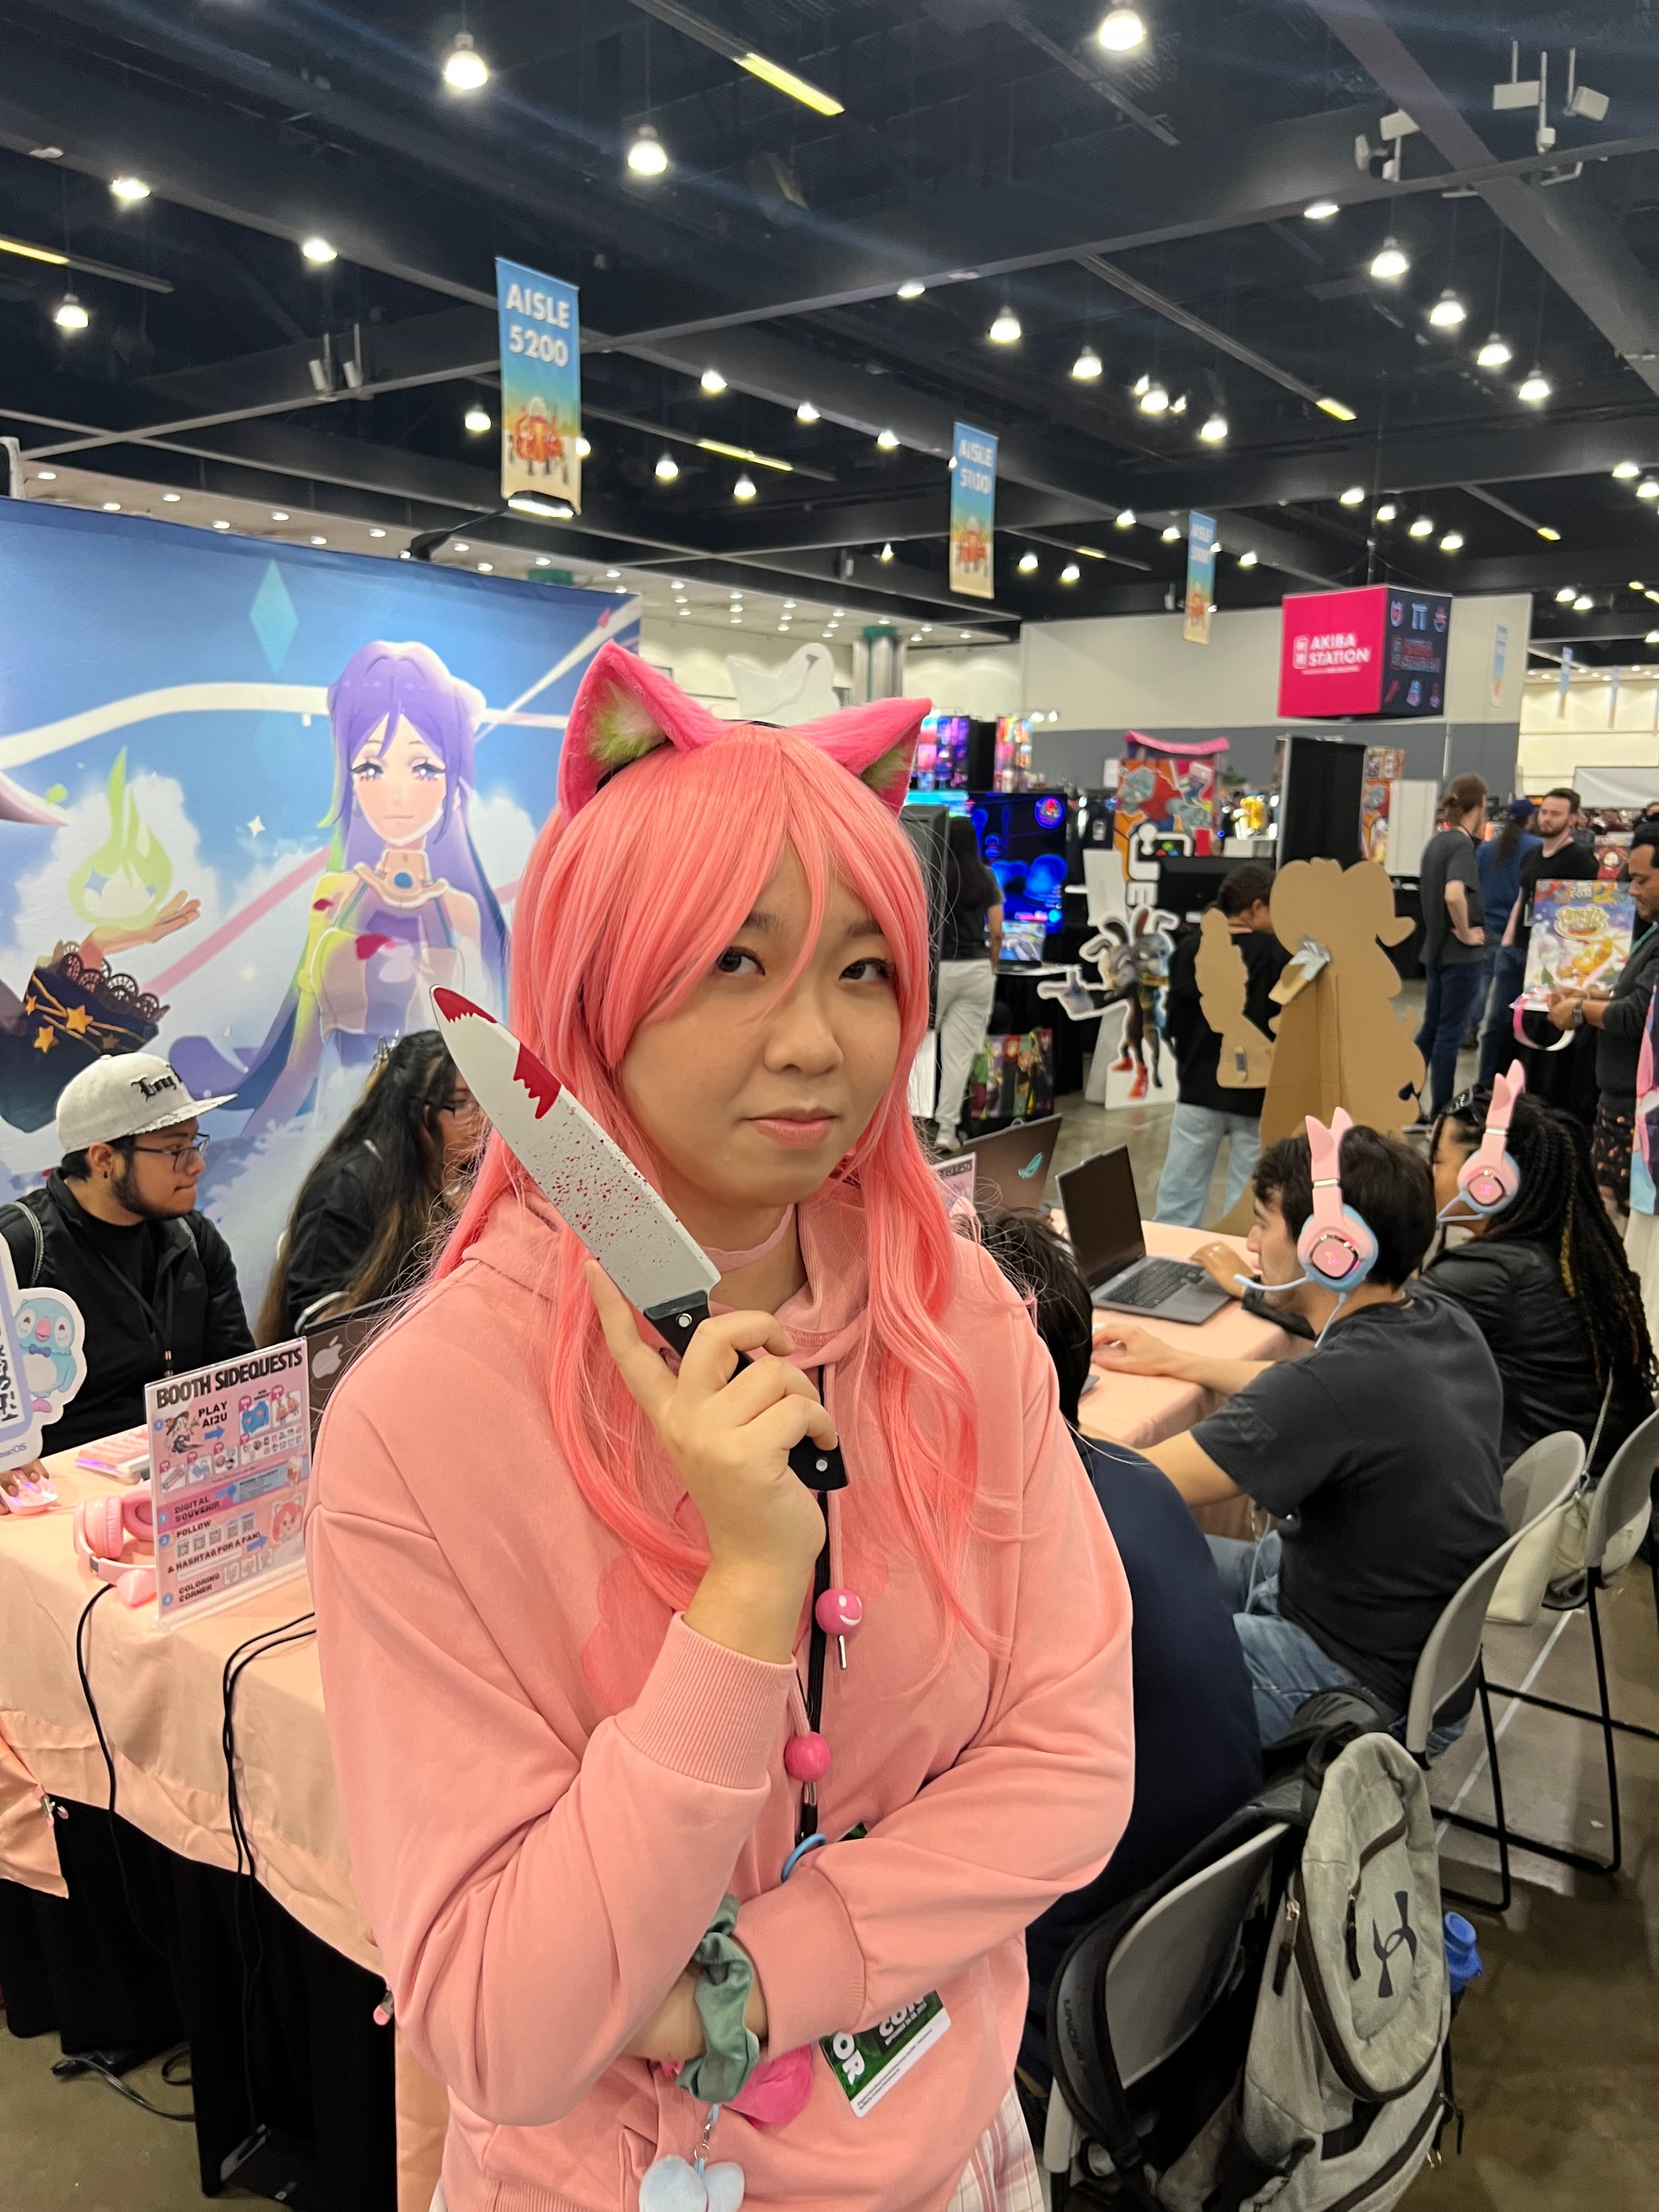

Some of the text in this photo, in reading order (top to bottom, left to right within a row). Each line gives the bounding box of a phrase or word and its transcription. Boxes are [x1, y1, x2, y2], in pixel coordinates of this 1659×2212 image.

[505, 284, 569, 329] AISLE
[509, 325, 568, 368] 5200
[959, 439, 992, 467] AISLE
[1310, 633, 1356, 650] AKIBA
[1308, 648, 1370, 667] STATION
[157, 1375, 212, 1409] BOOTH
[215, 1348, 302, 1391] SIDEQUESTS
[199, 1401, 228, 1418] PLAY
[174, 1496, 210, 1514] DIGITAL
[176, 1501, 220, 1523] SOUVENIR
[177, 1520, 211, 1538] FOLLOW
[176, 1548, 216, 1571] HASHTAG
[218, 1540, 234, 1555] FOR
[234, 1539, 241, 1549] A
